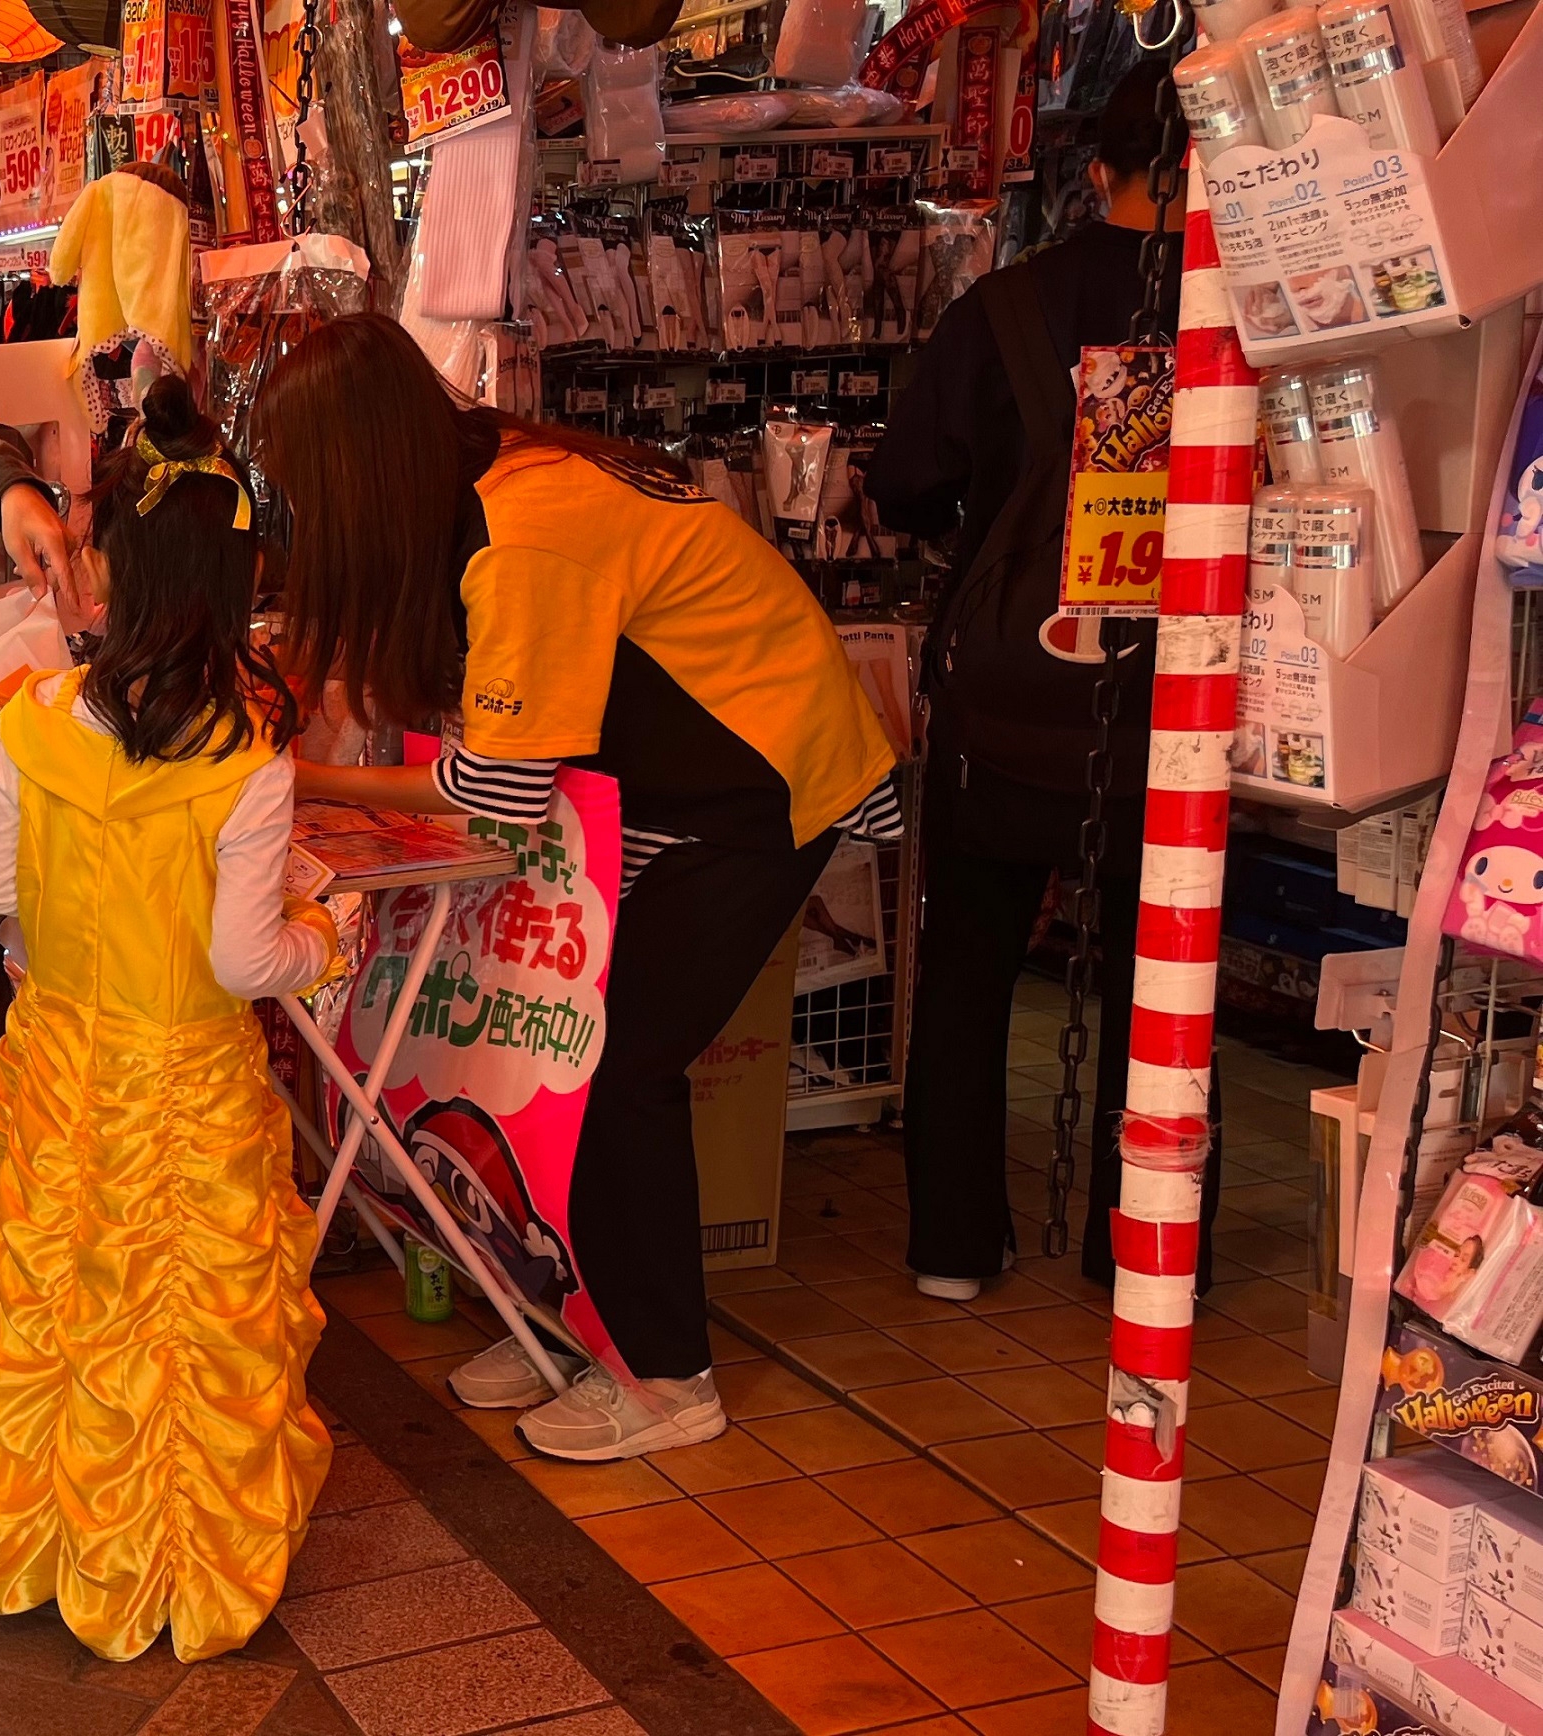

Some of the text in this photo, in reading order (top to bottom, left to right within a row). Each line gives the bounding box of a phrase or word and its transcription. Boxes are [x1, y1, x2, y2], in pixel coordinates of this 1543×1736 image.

[897, 8, 946, 49] Happy
[1264, 39, 1318, 71] 泡で磨く
[233, 38, 256, 134] Halloween
[419, 60, 503, 124] 1,290
[6, 146, 41, 194] 598
[1344, 154, 1404, 189] Point 03
[1268, 180, 1322, 210] Point 02
[1343, 185, 1408, 212] 5つの無添加
[730, 211, 787, 227] My Luxury
[823, 208, 853, 225] Luxury
[875, 208, 908, 224] Luxury
[1225, 201, 1246, 220] 01
[601, 218, 629, 235] Luxury
[1272, 221, 1329, 244] シェービング
[1098, 396, 1174, 472] Hallo
[863, 631, 895, 641] Pants
[1251, 638, 1267, 656] 02
[1300, 646, 1318, 664] 03
[1275, 667, 1317, 685] 5つの無添加
[361, 950, 596, 1069] クポン配布中!!
[698, 1036, 780, 1066] ポッキー
[1452, 1379, 1515, 1406] Get Excited
[1396, 1390, 1533, 1433] Halloween
